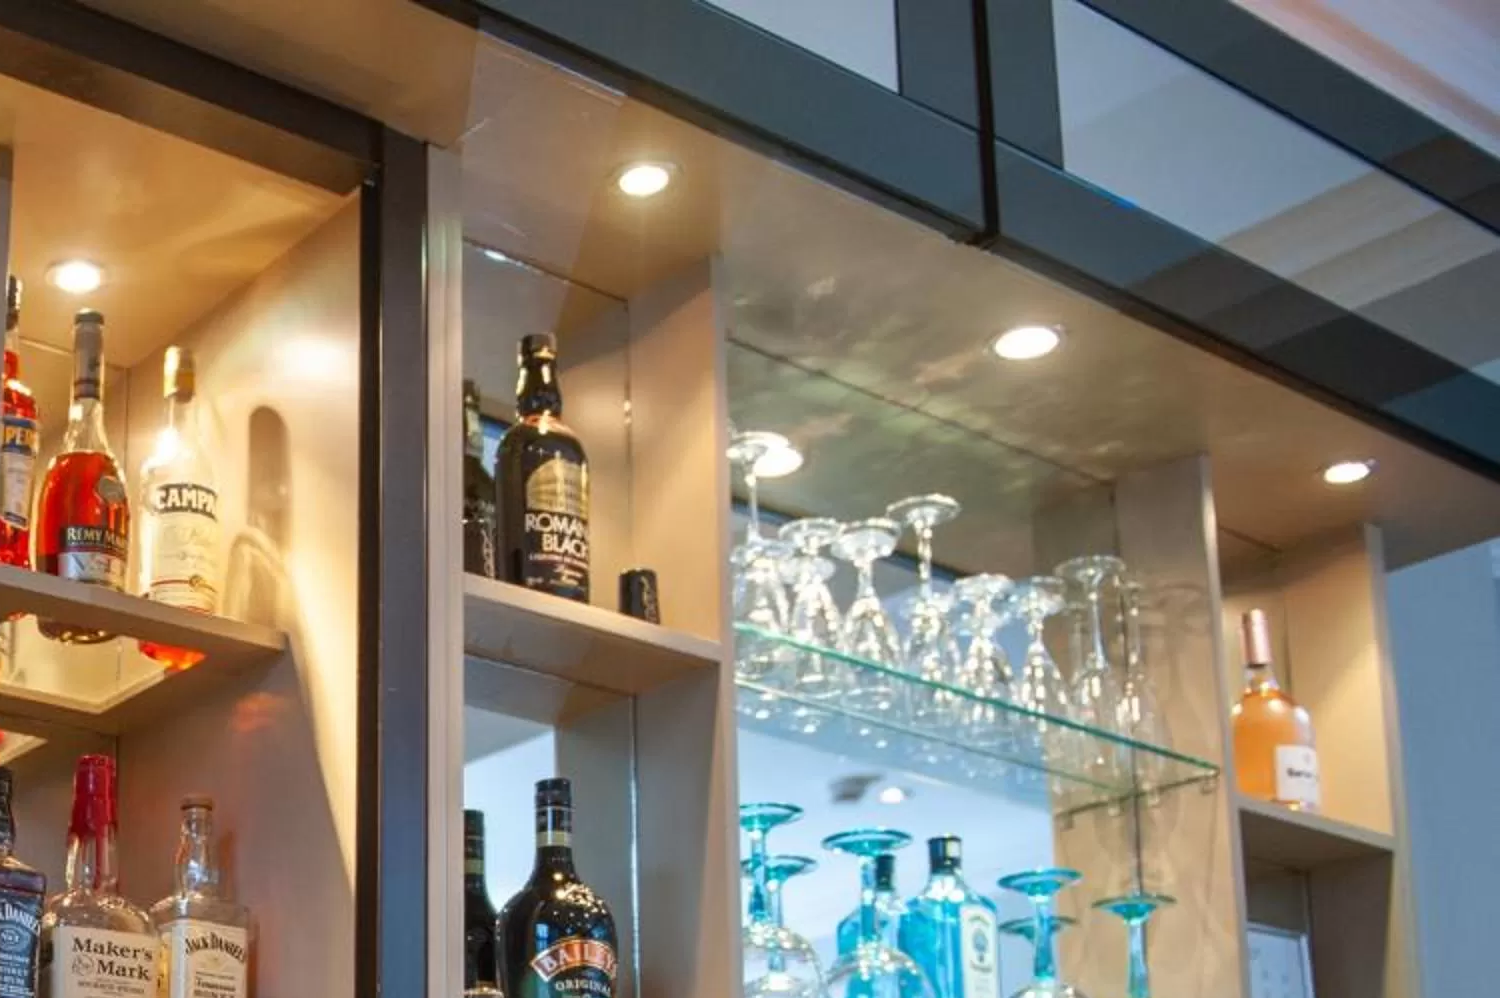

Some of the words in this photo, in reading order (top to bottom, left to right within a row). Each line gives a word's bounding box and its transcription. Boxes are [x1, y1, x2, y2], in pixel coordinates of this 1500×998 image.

[72, 937, 153, 961] Maker's
[97, 959, 151, 981] Mark
[554, 980, 612, 998] ORIGINAL
